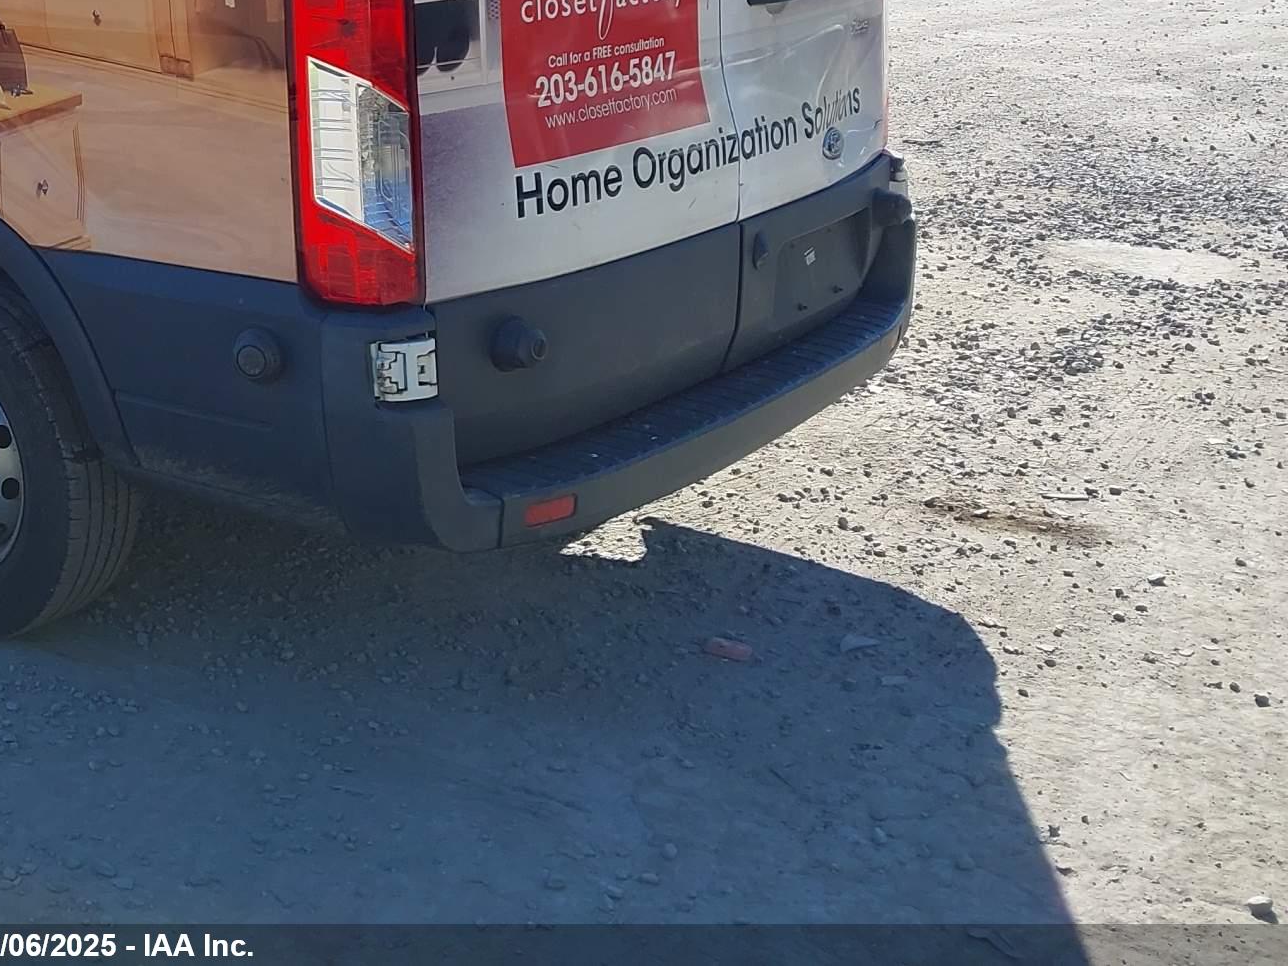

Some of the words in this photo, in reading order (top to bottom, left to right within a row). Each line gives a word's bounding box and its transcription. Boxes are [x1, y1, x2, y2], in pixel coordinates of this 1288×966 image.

[548, 54, 567, 68] Call
[569, 52, 582, 64] for
[584, 53, 590, 61] a
[593, 45, 612, 59] FREE
[614, 37, 664, 56] consultation
[536, 51, 676, 107] 203-616-5847
[545, 88, 677, 129] www.closetfactory.com
[516, 165, 623, 219] Home
[633, 116, 798, 193] Organization
